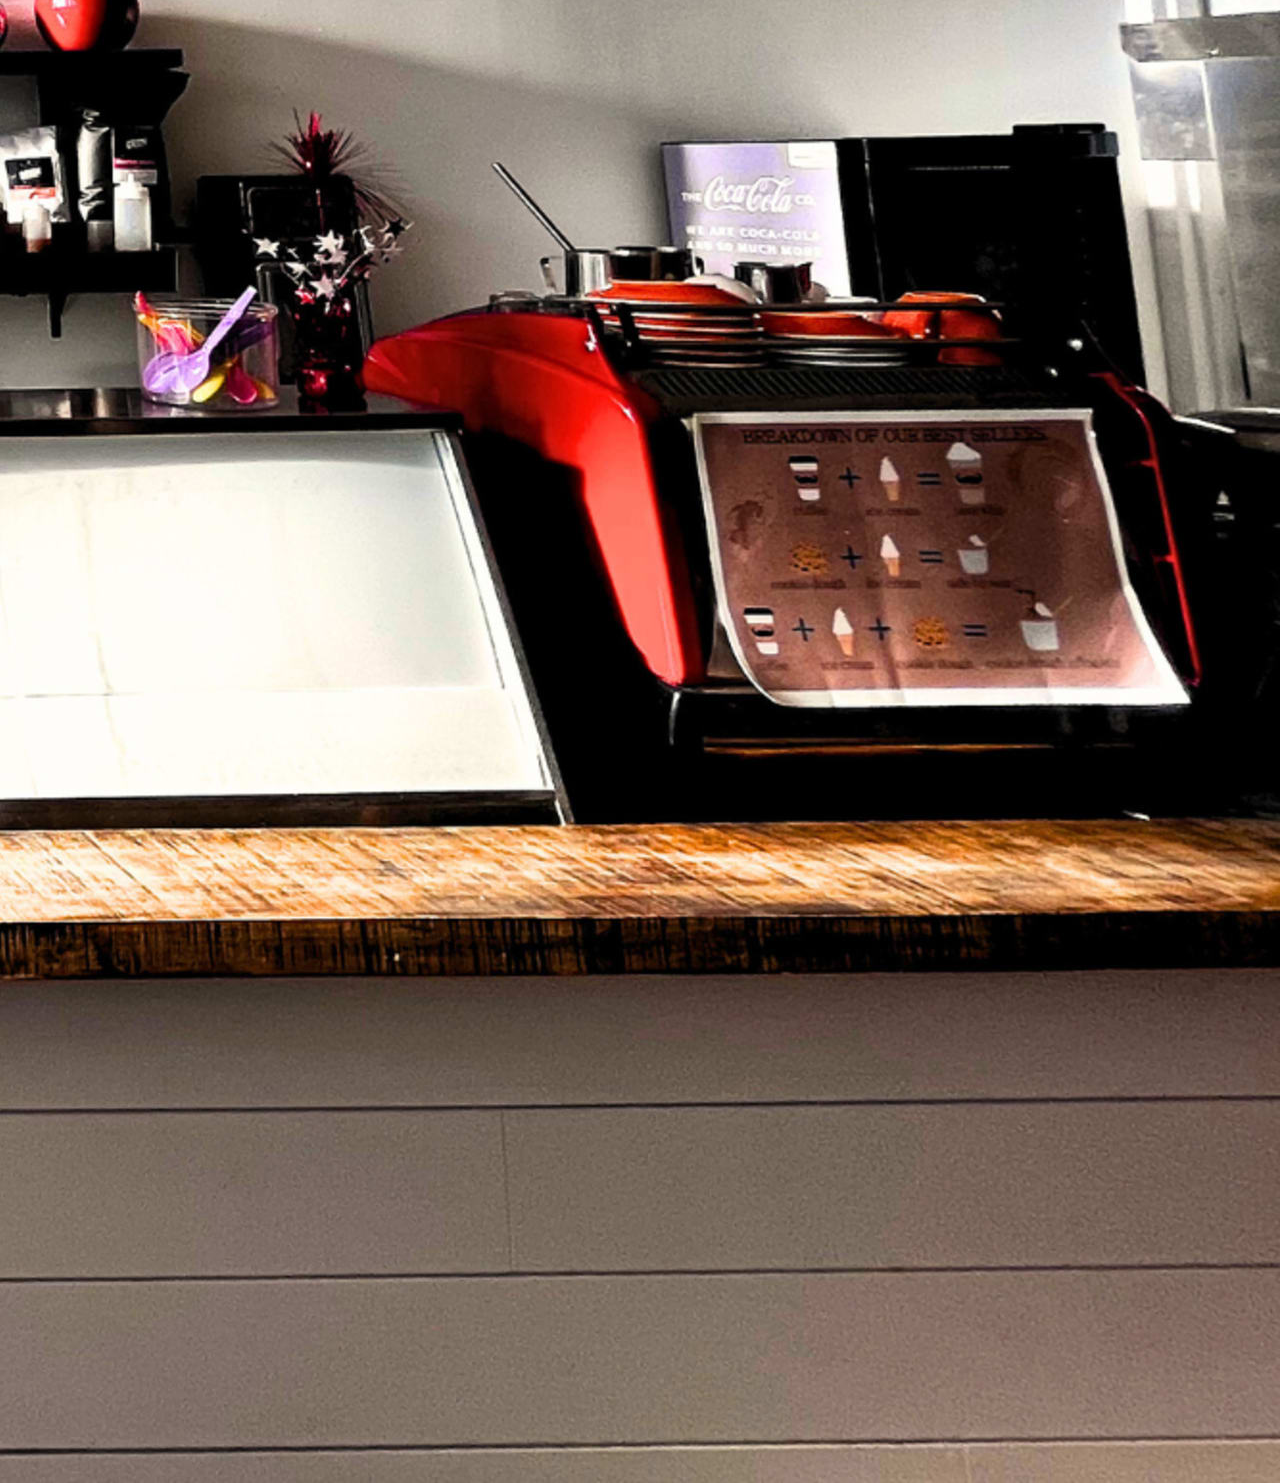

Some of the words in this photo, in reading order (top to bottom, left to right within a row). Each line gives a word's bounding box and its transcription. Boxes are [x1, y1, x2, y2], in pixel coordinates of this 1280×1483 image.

[682, 193, 702, 201] THE
[686, 226, 703, 235] WE
[710, 227, 734, 236] ARE
[741, 228, 820, 241] COCA-COLA
[687, 242, 712, 251] AND
[717, 242, 733, 251] SO
[738, 243, 777, 254] MUCH
[781, 246, 822, 256] MORE
[743, 430, 851, 444] BREAKDOWN
[855, 430, 879, 442] OF
[884, 429, 919, 442] OUR
[923, 429, 966, 442] BEST
